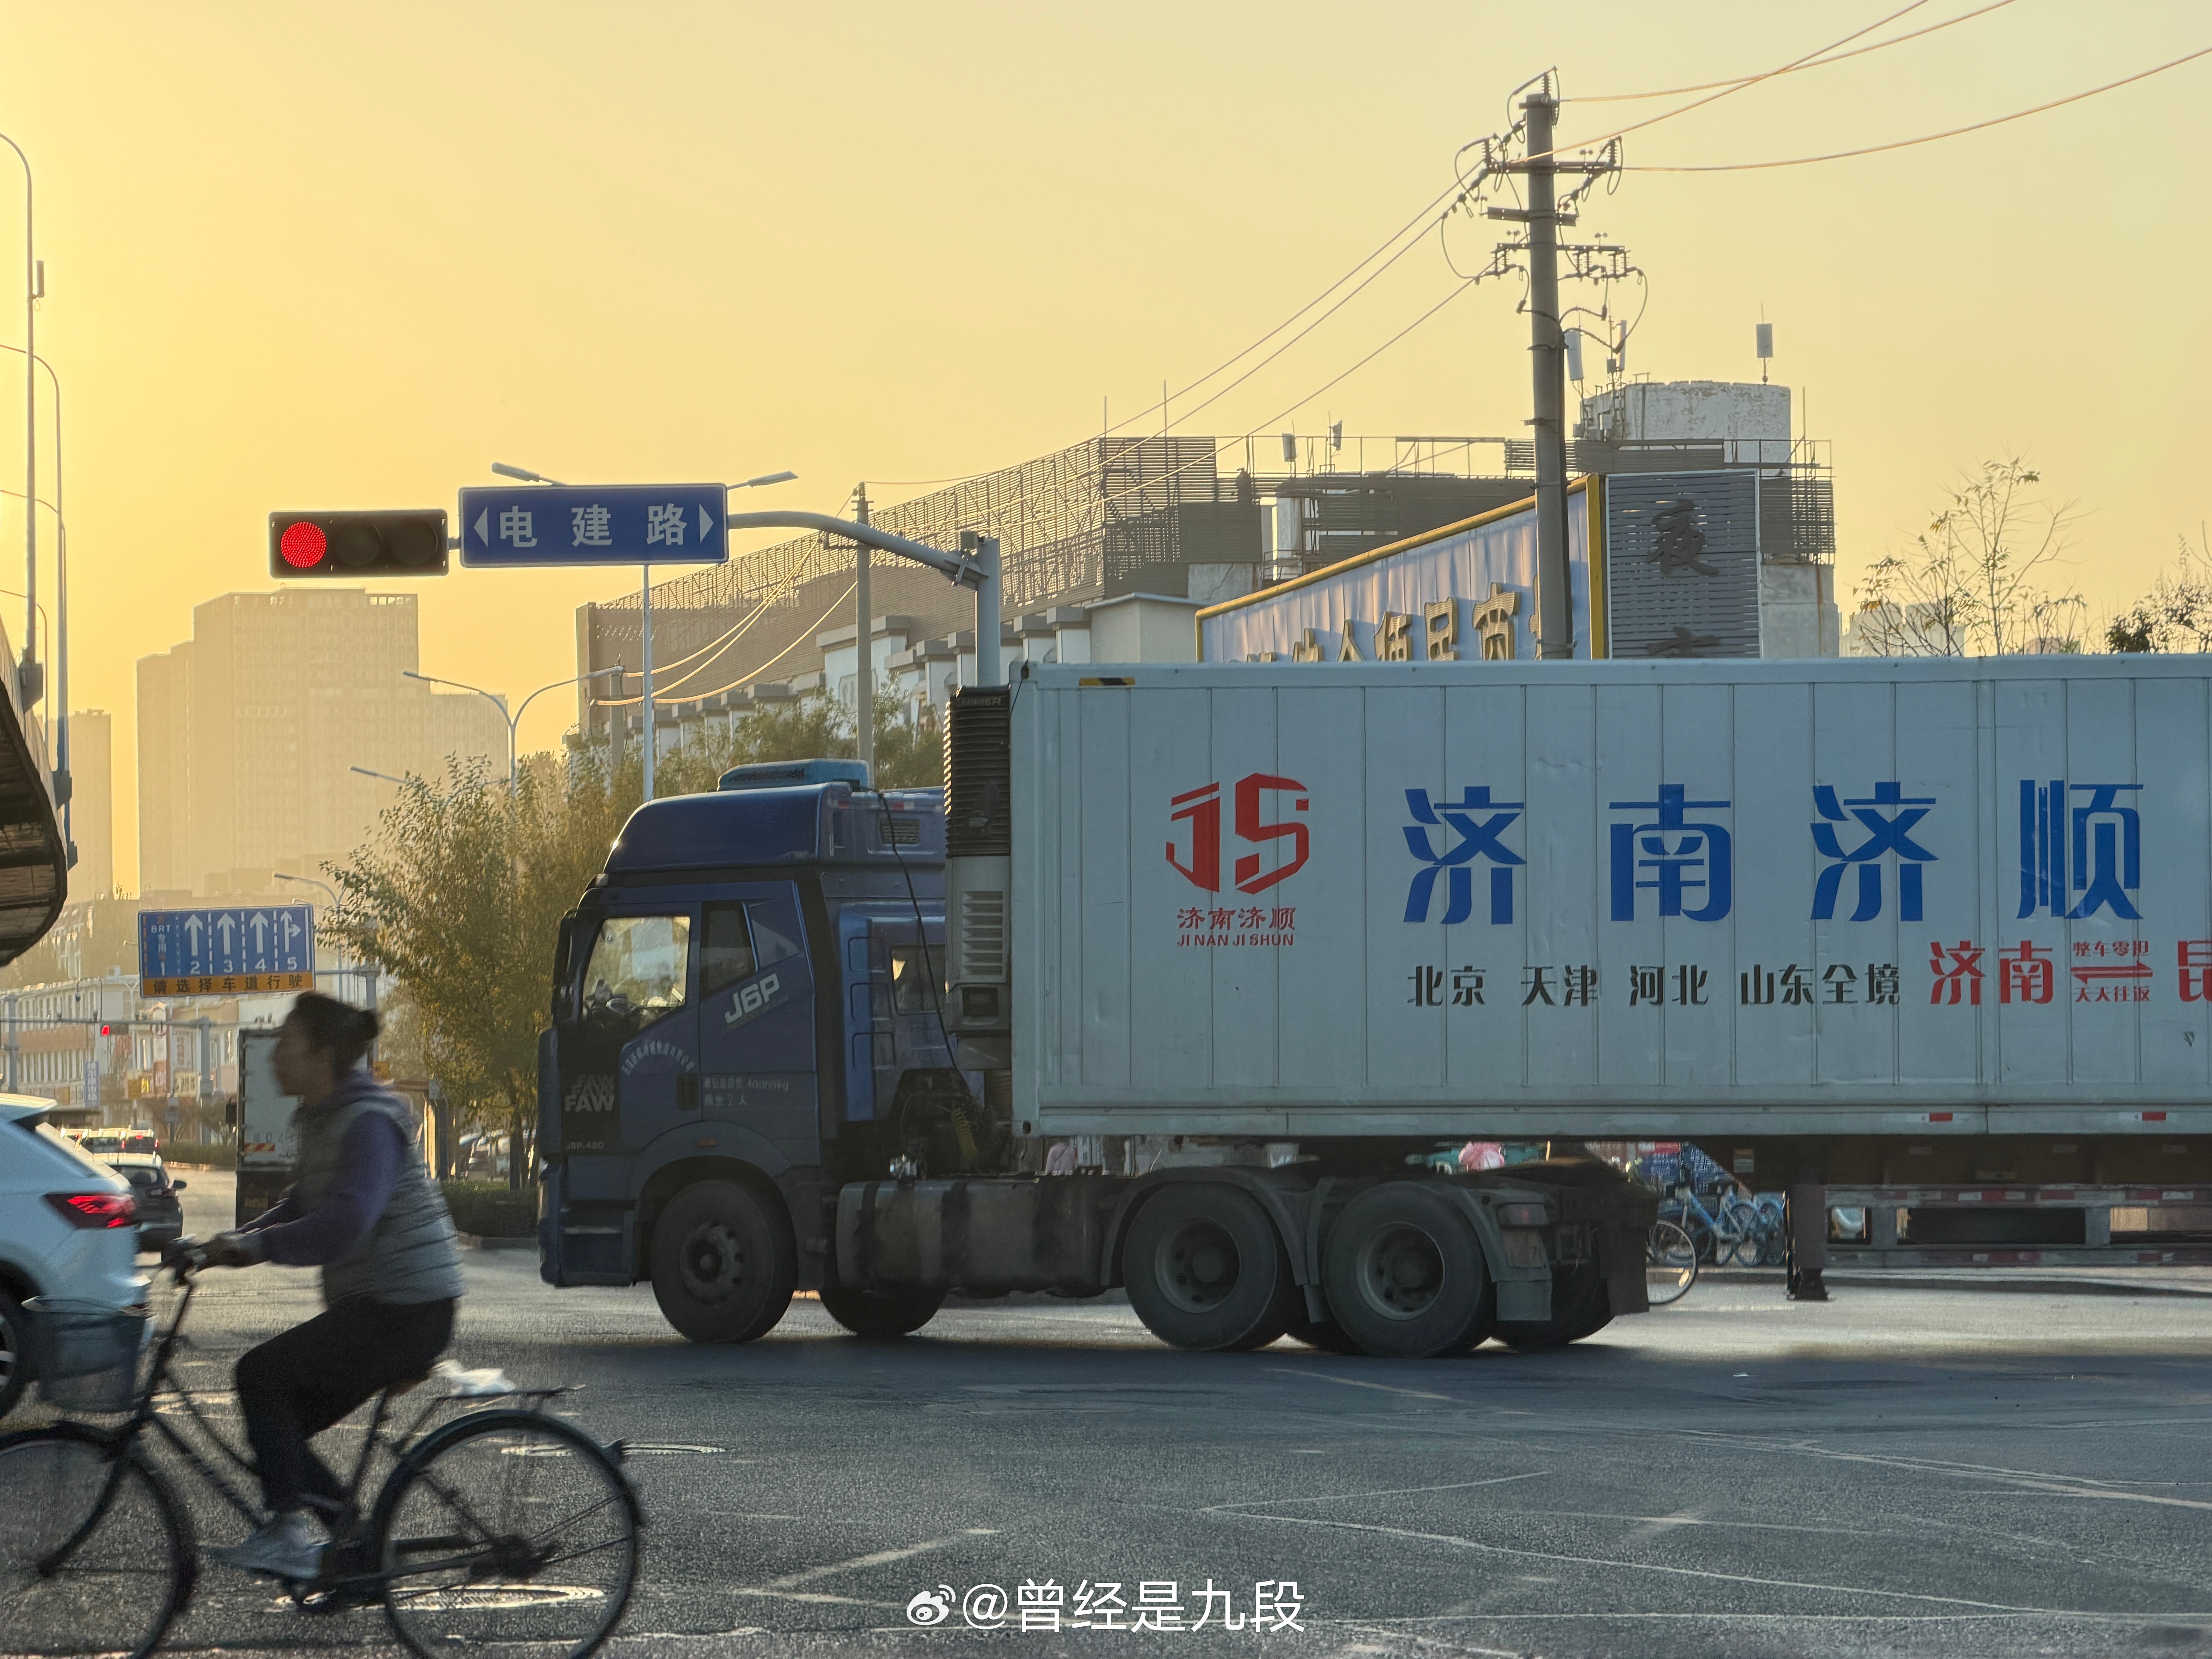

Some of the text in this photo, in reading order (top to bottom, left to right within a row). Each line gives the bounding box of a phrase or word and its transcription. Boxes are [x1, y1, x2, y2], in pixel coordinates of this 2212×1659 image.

[499, 503, 687, 548] 电建路
[1402, 780, 2144, 925] 济南济顺
[1177, 907, 1296, 931] 济南济顺
[151, 924, 171, 933] BRT
[2073, 940, 2149, 957] 整车零担
[160, 961, 165, 976] 1
[190, 961, 201, 975] 2
[223, 959, 233, 973] 3
[254, 958, 266, 972] 4
[287, 956, 297, 970] 5
[1929, 940, 2054, 1005] 济南
[153, 973, 302, 994] 请选择车道行驶
[1407, 963, 1900, 1007] 北京 天津 河北 山东全境
[725, 973, 780, 1024] J6P
[2074, 986, 2150, 1003] 天天往返
[564, 1094, 615, 1112] FAW
